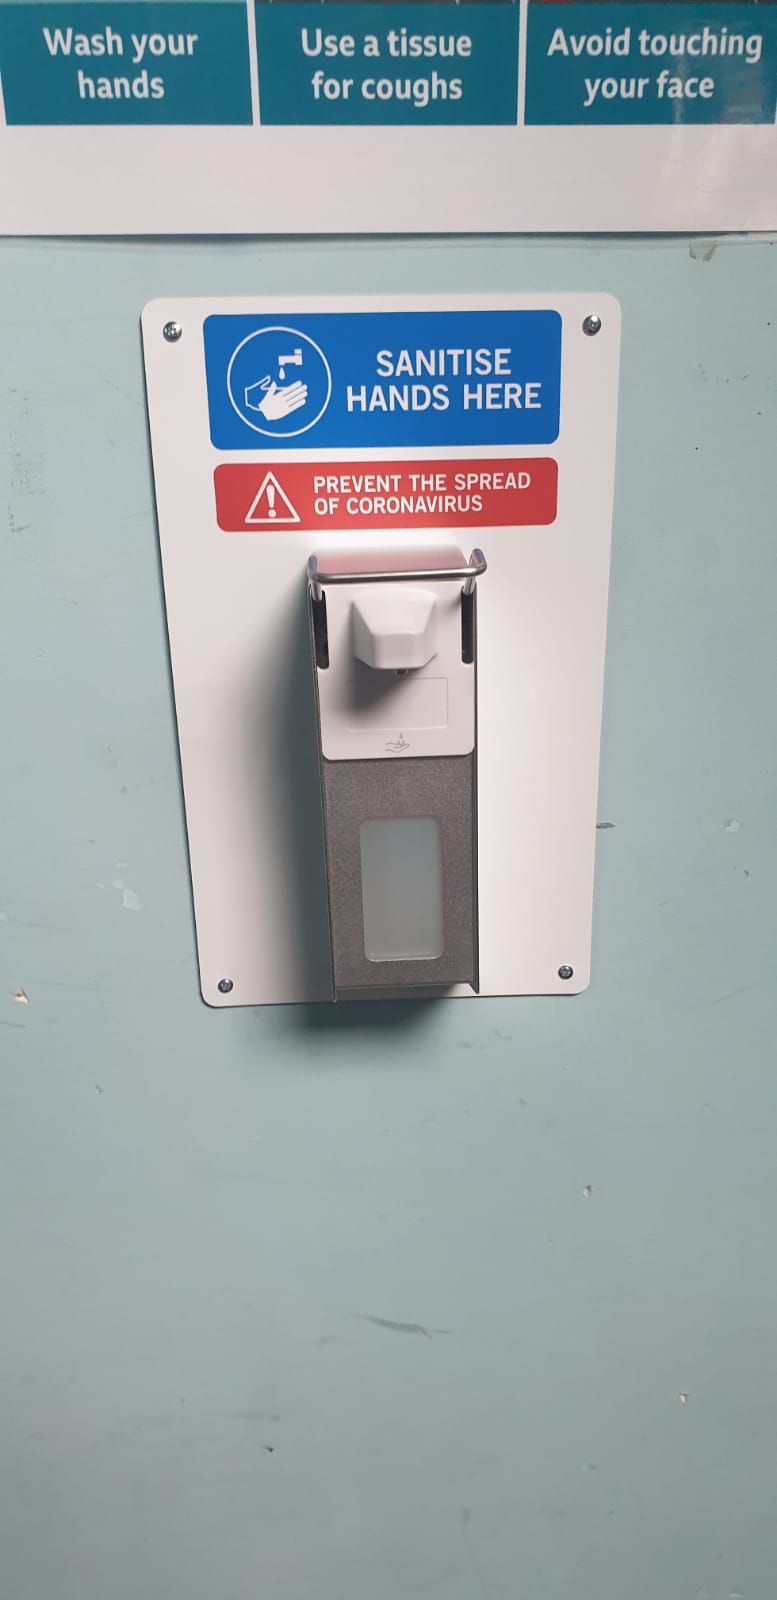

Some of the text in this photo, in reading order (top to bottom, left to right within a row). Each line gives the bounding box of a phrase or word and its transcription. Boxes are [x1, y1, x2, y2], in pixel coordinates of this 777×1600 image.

[42, 26, 198, 63] Wash your
[301, 27, 472, 57] Use a tissue
[547, 26, 763, 64] Avoid touching
[77, 69, 165, 99] hands
[311, 70, 463, 108] for coughs
[583, 69, 715, 107] your face
[376, 348, 512, 377] SANITISE
[346, 382, 542, 412] HANDS HERE
[313, 471, 531, 494] PREVENT THE SPREAD
[314, 494, 483, 516] OF CORONAVIRUS
